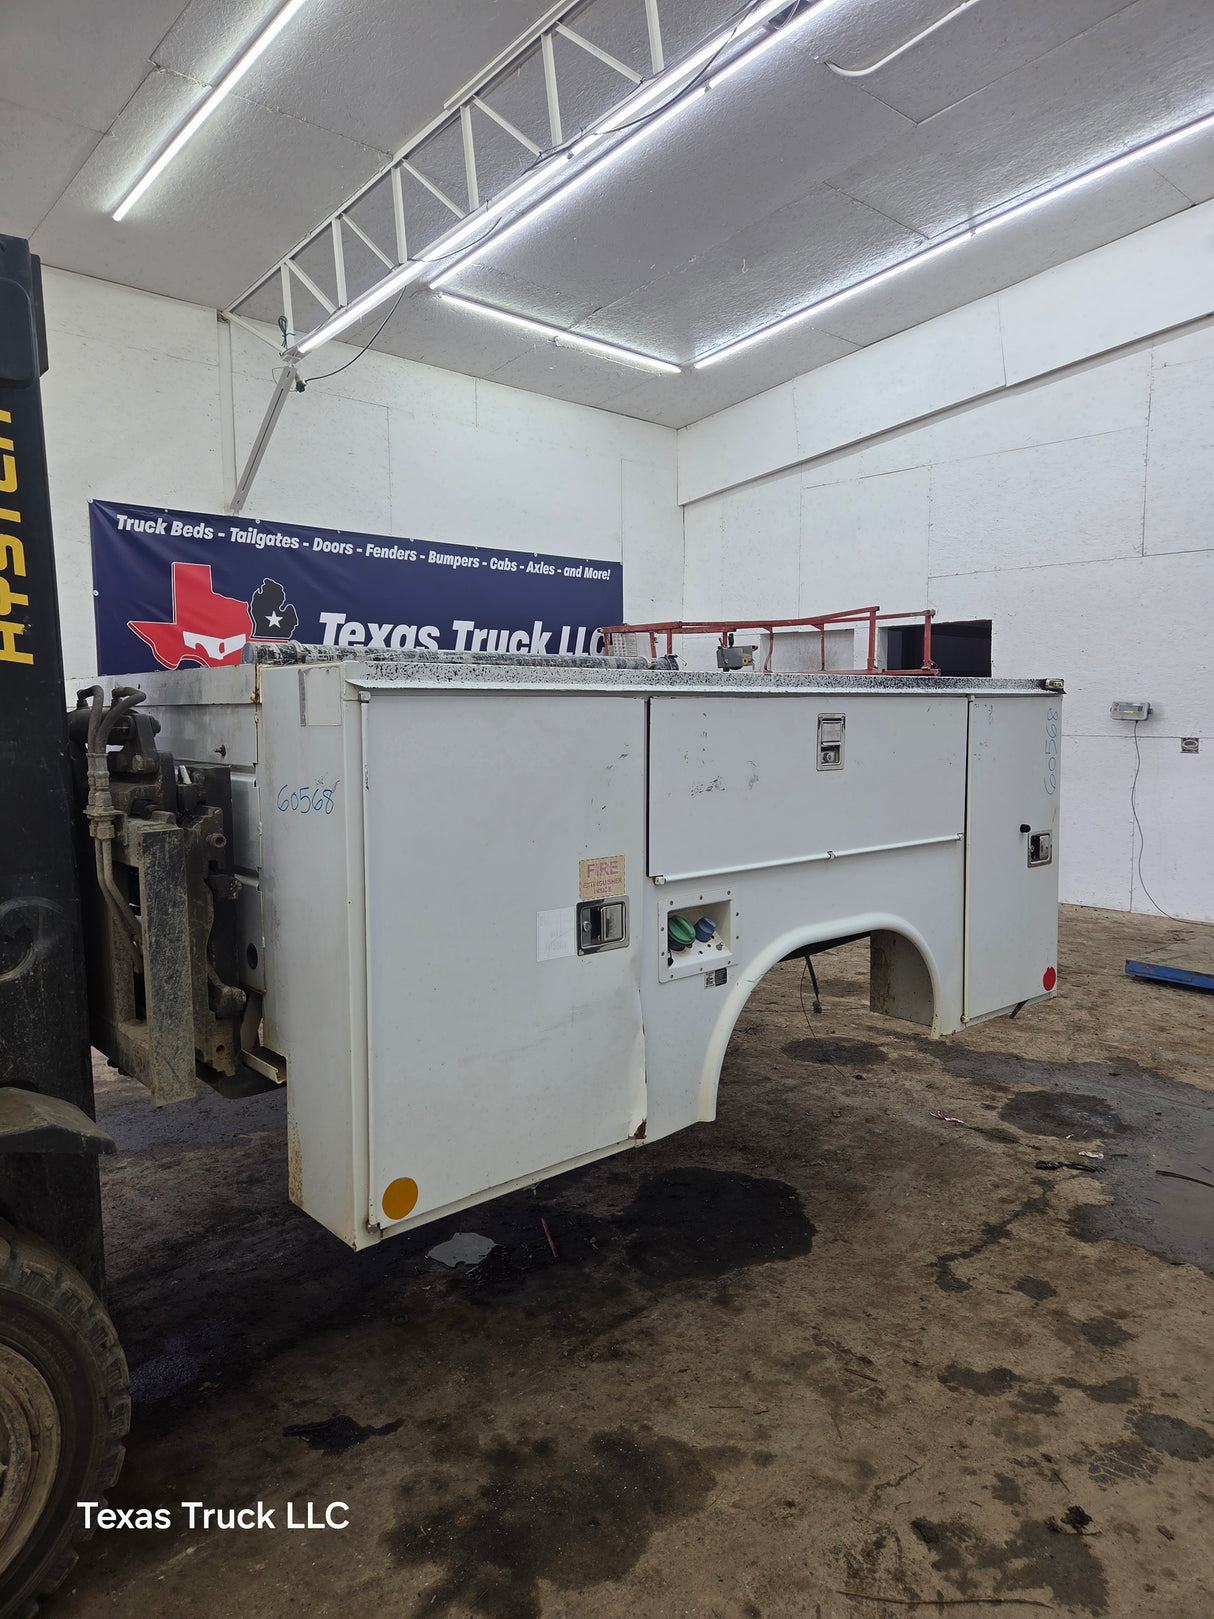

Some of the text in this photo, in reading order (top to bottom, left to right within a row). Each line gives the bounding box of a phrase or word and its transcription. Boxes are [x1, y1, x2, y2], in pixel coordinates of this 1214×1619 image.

[0, 409, 34, 665] HYS
[116, 514, 168, 535] Truck
[170, 520, 214, 540] Beds
[229, 527, 300, 549] Tailgates
[312, 537, 354, 555] Doors
[365, 543, 418, 562] Fenders
[427, 550, 480, 570] Bumpers
[489, 557, 518, 572] Cabs
[525, 560, 556, 576] Axles
[563, 566, 583, 578] and
[583, 566, 611, 581] More!
[319, 612, 441, 651] Texas
[452, 619, 552, 654] Truck
[558, 625, 605, 656] LLC
[1044, 707, 1058, 796] 60568
[276, 784, 335, 815] 60568
[587, 861, 618, 878] FIRE
